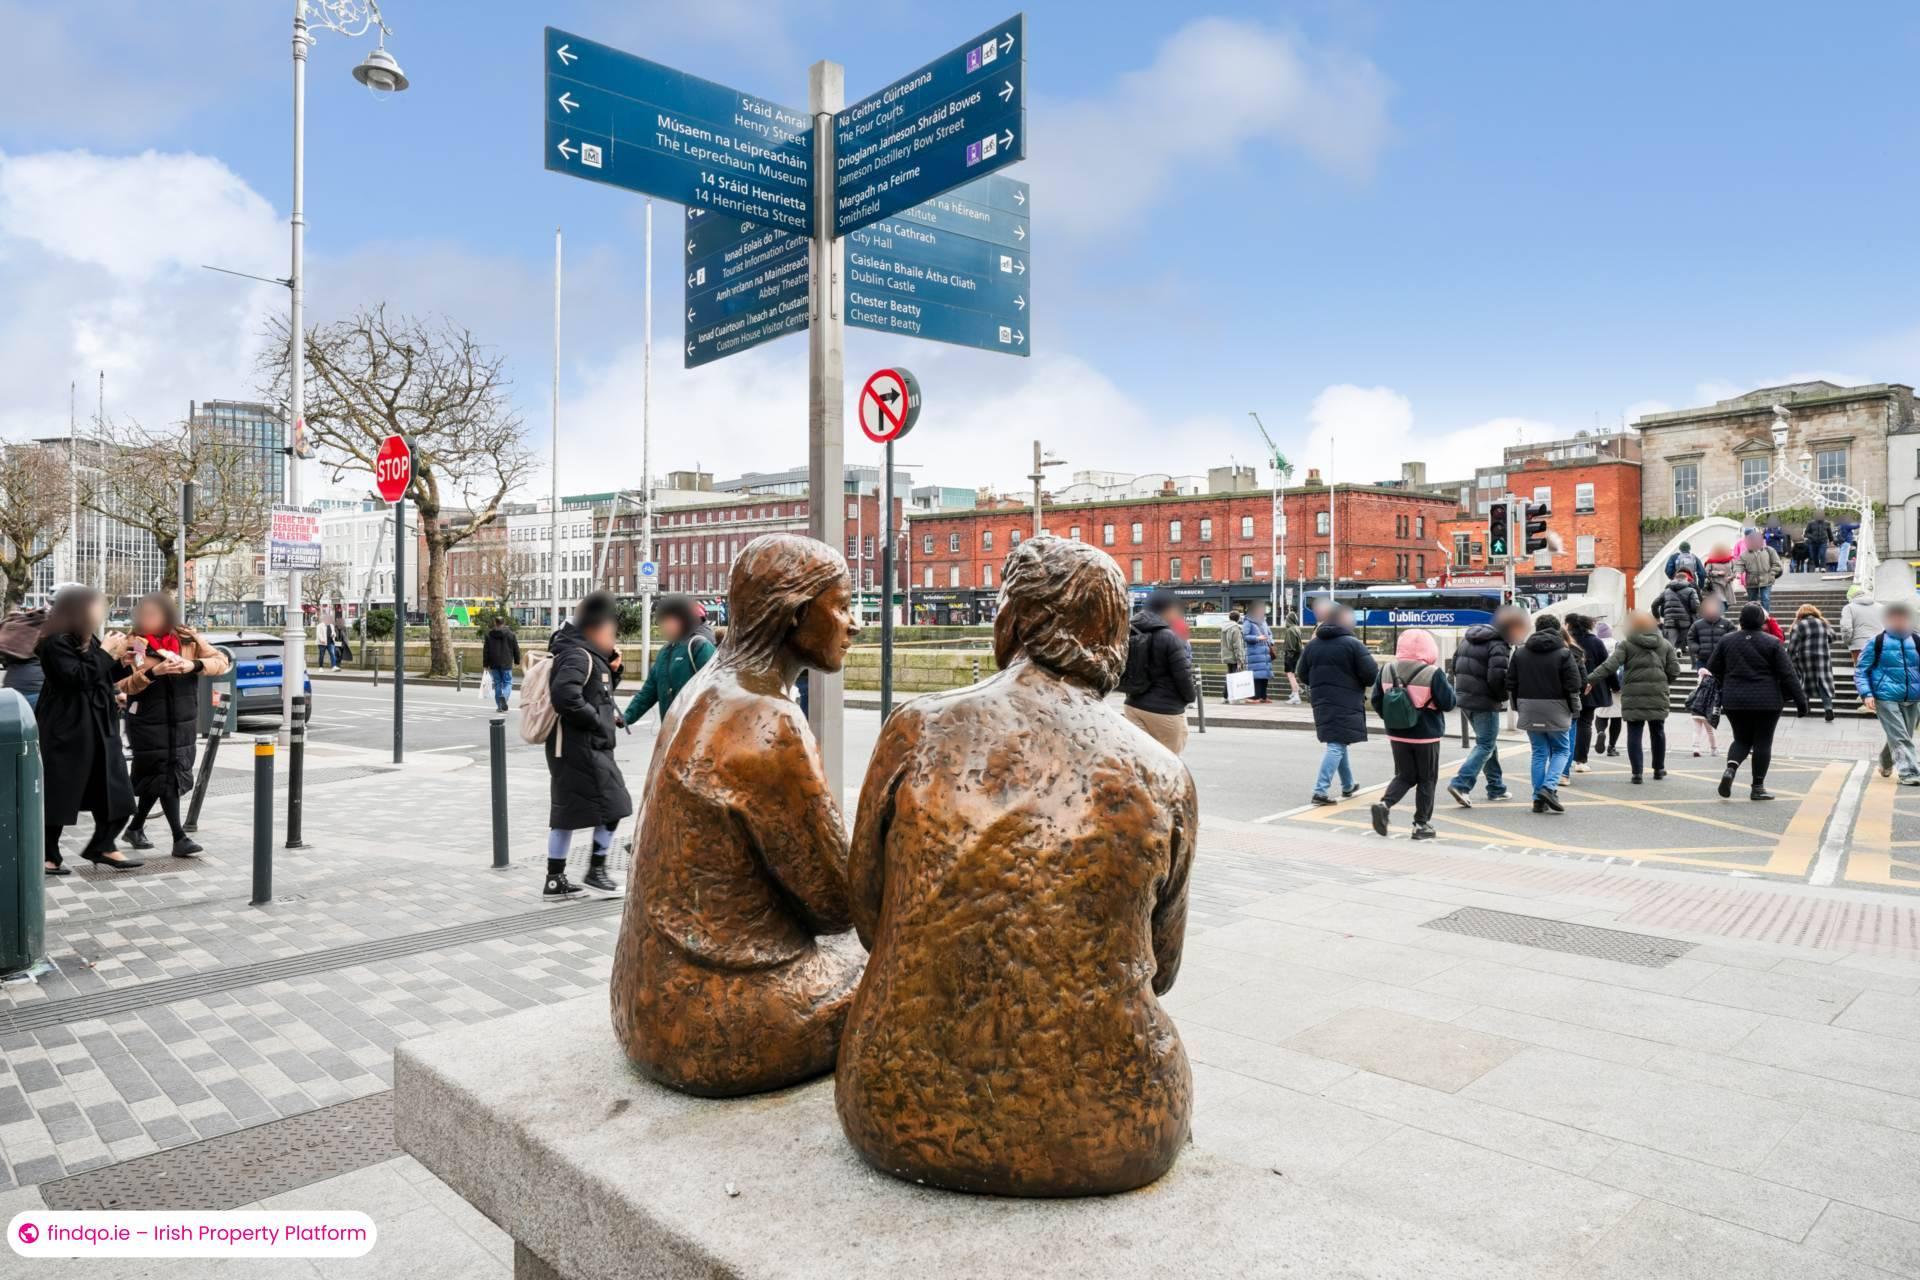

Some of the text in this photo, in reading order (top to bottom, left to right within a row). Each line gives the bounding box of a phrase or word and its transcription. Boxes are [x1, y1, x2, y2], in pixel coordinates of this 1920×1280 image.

[742, 98, 772, 120] Sráid
[839, 72, 932, 128] Na Ceithre Cúirteanna
[735, 114, 806, 147] Henry Street
[838, 91, 981, 169] Drioglann Jameson Shráid Bowes
[840, 105, 903, 144] The Four Courts
[658, 114, 806, 170] Músaem na Leipreacháin
[838, 118, 964, 187] Jameson Distillery Bow Street
[656, 133, 806, 188] The Leprechaun Museum
[701, 172, 805, 211] 14 Sráid Henrietta
[839, 167, 920, 210] Margadh na Feirme
[695, 188, 805, 228] 14 Henrietta Street
[839, 200, 880, 227] Smithfield
[939, 201, 948, 211] na
[952, 201, 990, 223] hÉireann
[725, 247, 742, 262] Ionad
[744, 237, 762, 253] Eolais
[764, 234, 772, 244] do
[852, 232, 892, 249] City Hall
[880, 223, 891, 233] na
[894, 225, 935, 244] Cathrach
[723, 236, 809, 278] Tourist Information Centre
[755, 274, 763, 286] na
[765, 256, 808, 281] Mainistreach
[759, 272, 808, 300] Abbey Theatre
[851, 253, 976, 291] Caisleán Bhaile Átha Cliath
[852, 270, 916, 293] Dublin Castle
[769, 307, 777, 316] an
[779, 295, 808, 313] Chustaim
[851, 293, 921, 317] Chester Beatty
[717, 312, 809, 351] Custom House Visitor Centre
[851, 309, 921, 333] Chester Beatty
[378, 456, 409, 483] STOP
[273, 514, 296, 523] THERE
[298, 516, 304, 524] IS
[273, 523, 319, 534] CEASEFIRE IN
